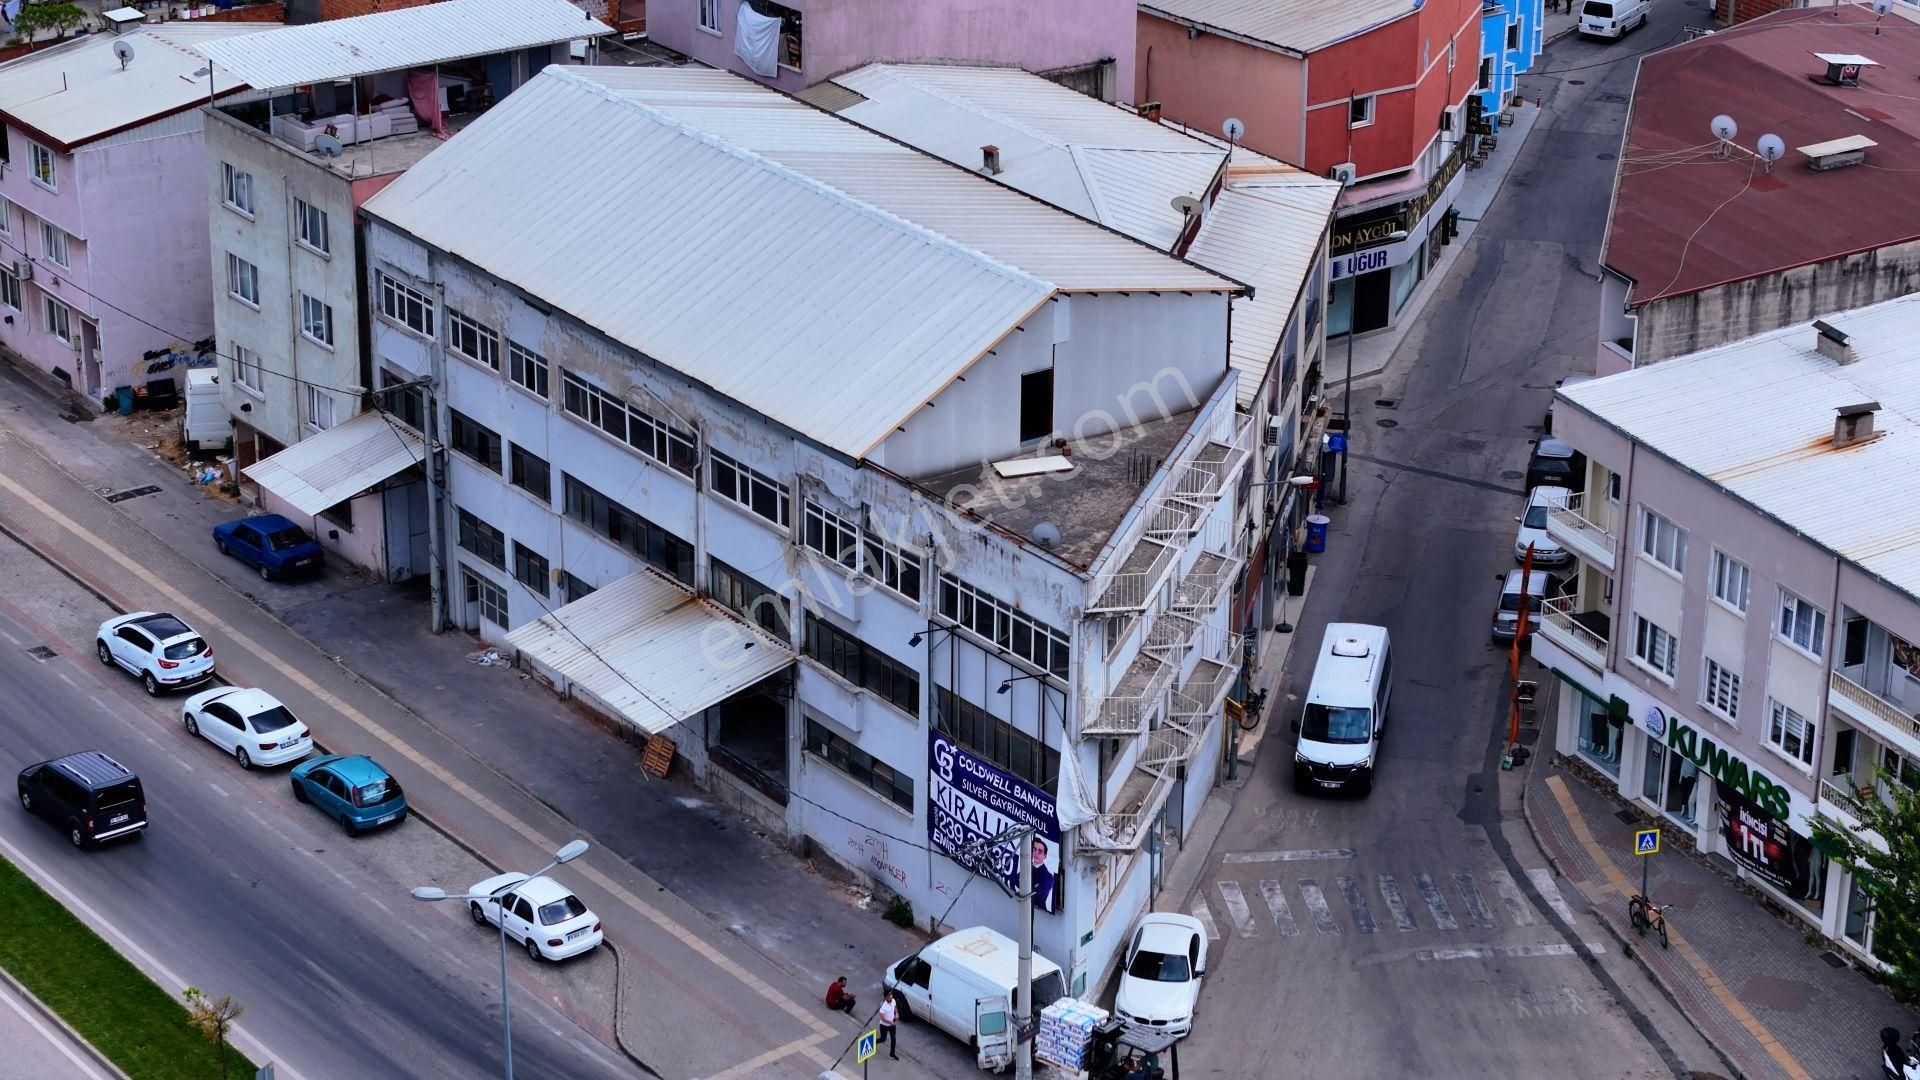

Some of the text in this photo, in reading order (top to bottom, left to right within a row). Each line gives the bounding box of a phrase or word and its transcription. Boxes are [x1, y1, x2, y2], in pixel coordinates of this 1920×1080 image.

[1355, 221, 1397, 242] AYGÜL
[1348, 250, 1388, 274] UĞUR
[1668, 717, 1791, 820] KUWARS
[958, 755, 1054, 818] COLDWELL BANKER
[962, 778, 988, 801] SILVER
[938, 810, 963, 845] 239
[1740, 825, 1749, 853] 1
[1750, 833, 1769, 865] TL
